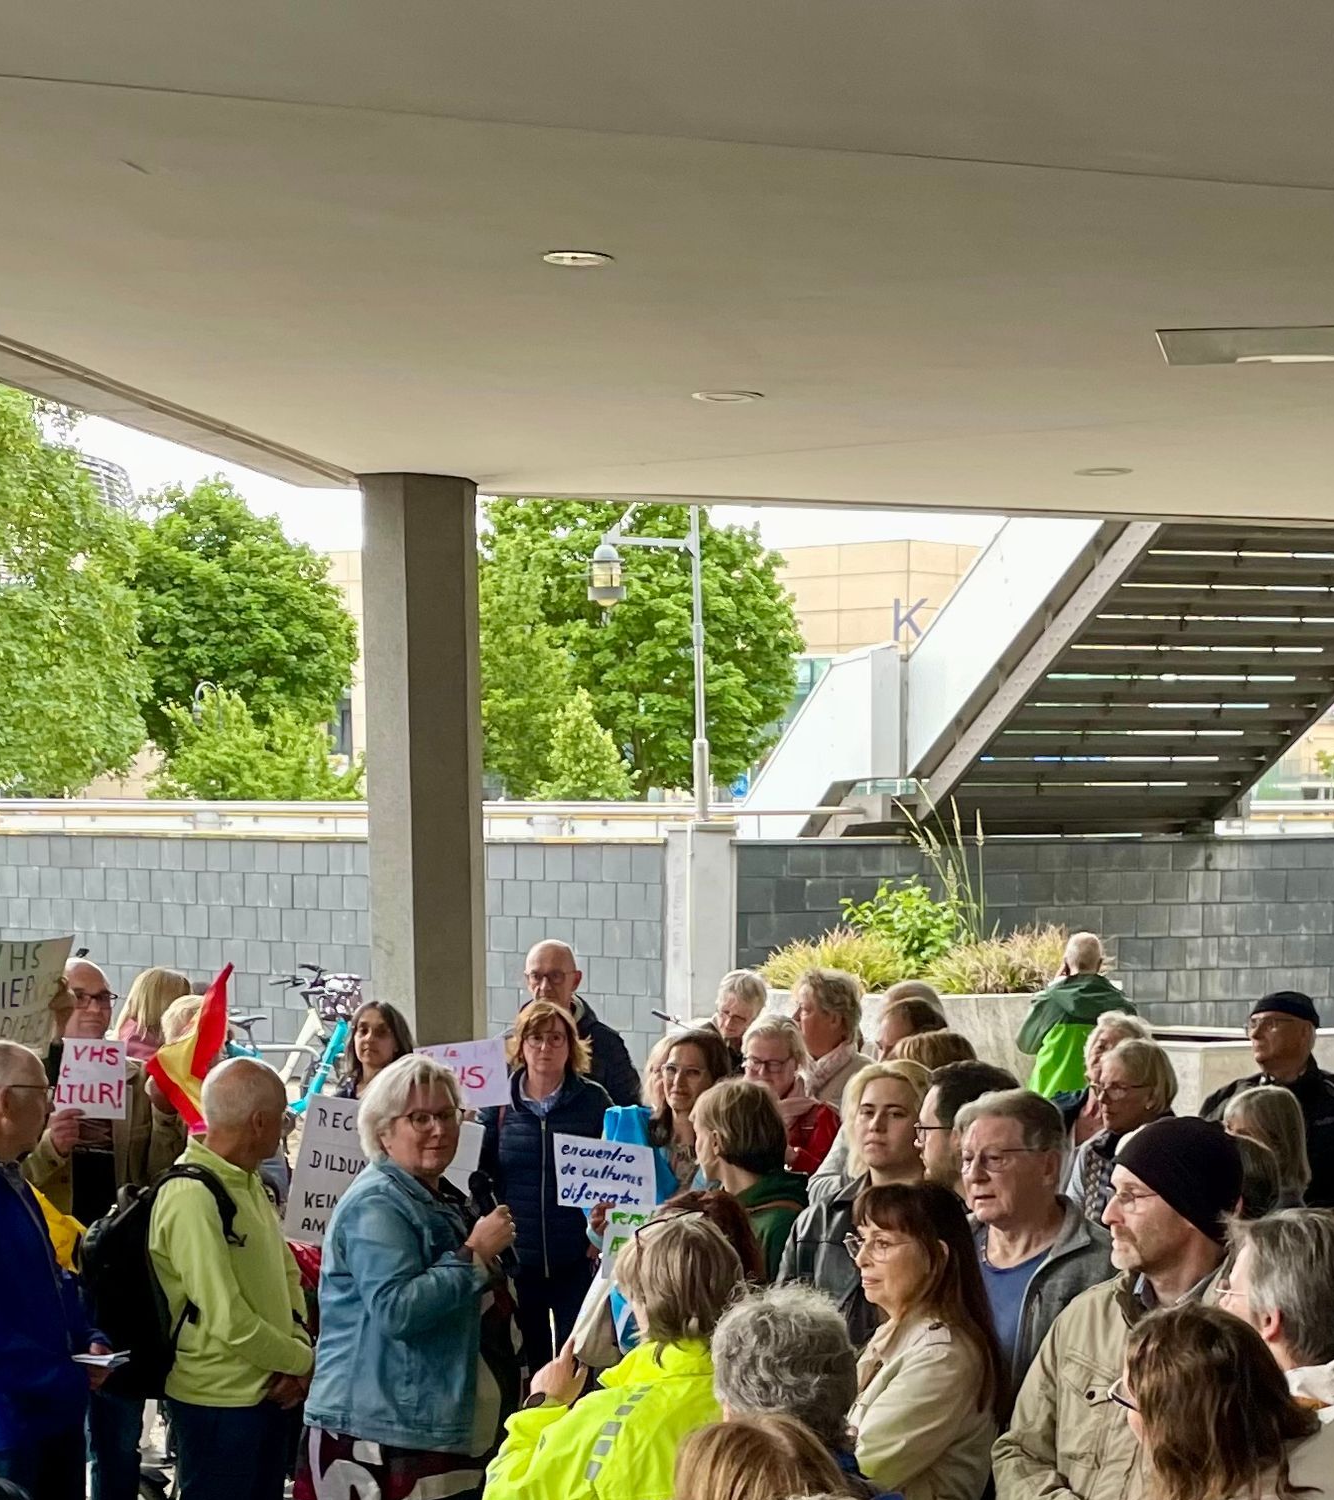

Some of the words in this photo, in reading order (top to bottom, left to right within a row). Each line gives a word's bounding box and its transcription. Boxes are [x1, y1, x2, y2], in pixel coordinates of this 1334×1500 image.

[73, 1045, 120, 1066] VHS
[62, 1063, 71, 1078] t
[56, 1079, 124, 1110] LTUR!
[318, 1107, 358, 1131] REC
[309, 1150, 367, 1175] BILDUN
[561, 1144, 635, 1163] encuentro
[561, 1163, 577, 1175] de
